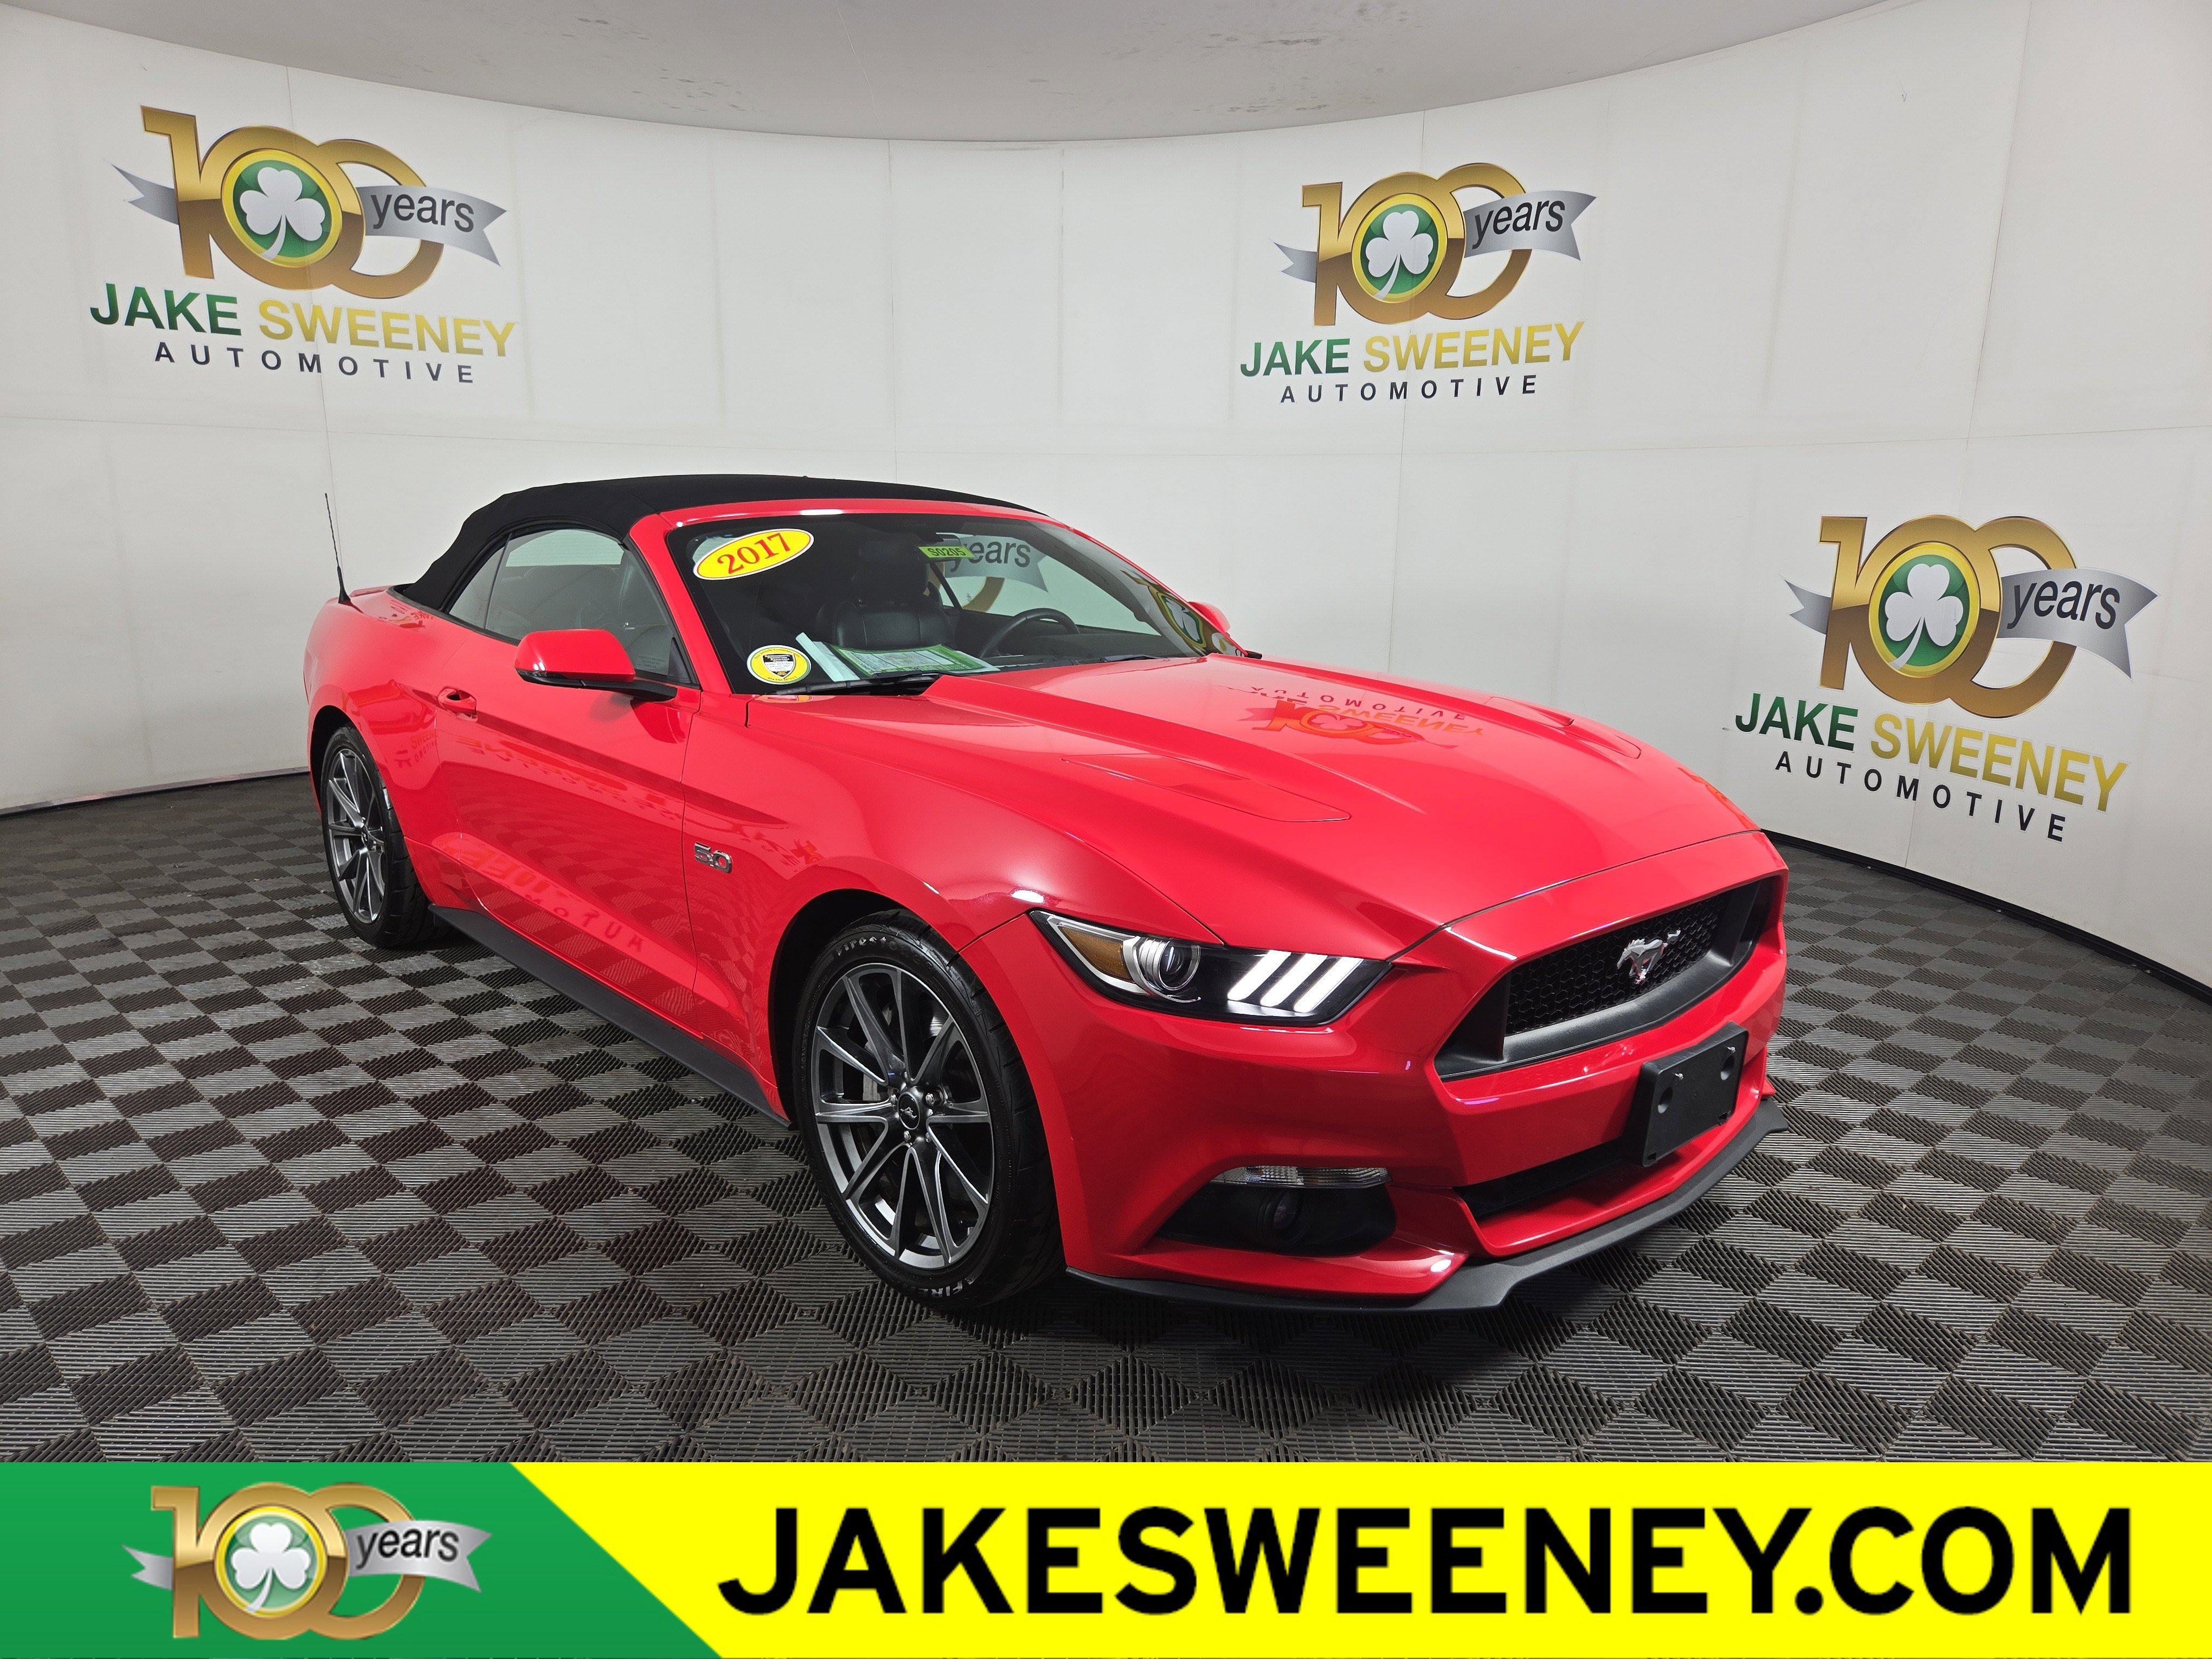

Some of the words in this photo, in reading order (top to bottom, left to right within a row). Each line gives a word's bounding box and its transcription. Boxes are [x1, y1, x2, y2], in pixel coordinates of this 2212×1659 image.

[141, 105, 445, 299] 100
[370, 192, 474, 232] years
[1302, 163, 1533, 326] 100
[1472, 200, 1565, 249] years
[91, 282, 242, 336] JAKE
[259, 300, 516, 357] SWEENEY
[1240, 338, 1350, 377] JAKE
[1363, 321, 1585, 372] SWEENEY
[154, 342, 474, 383] AUTOMOTIVE
[1281, 375, 1536, 403] AUTOMOTIVE
[717, 533, 791, 574] 2017
[1819, 515, 2078, 718] 100
[2007, 581, 2121, 629] years
[1735, 693, 1859, 751] JAKE
[1871, 713, 2129, 813] SWEENEY
[1776, 751, 2066, 842] AUTOMOTIVE
